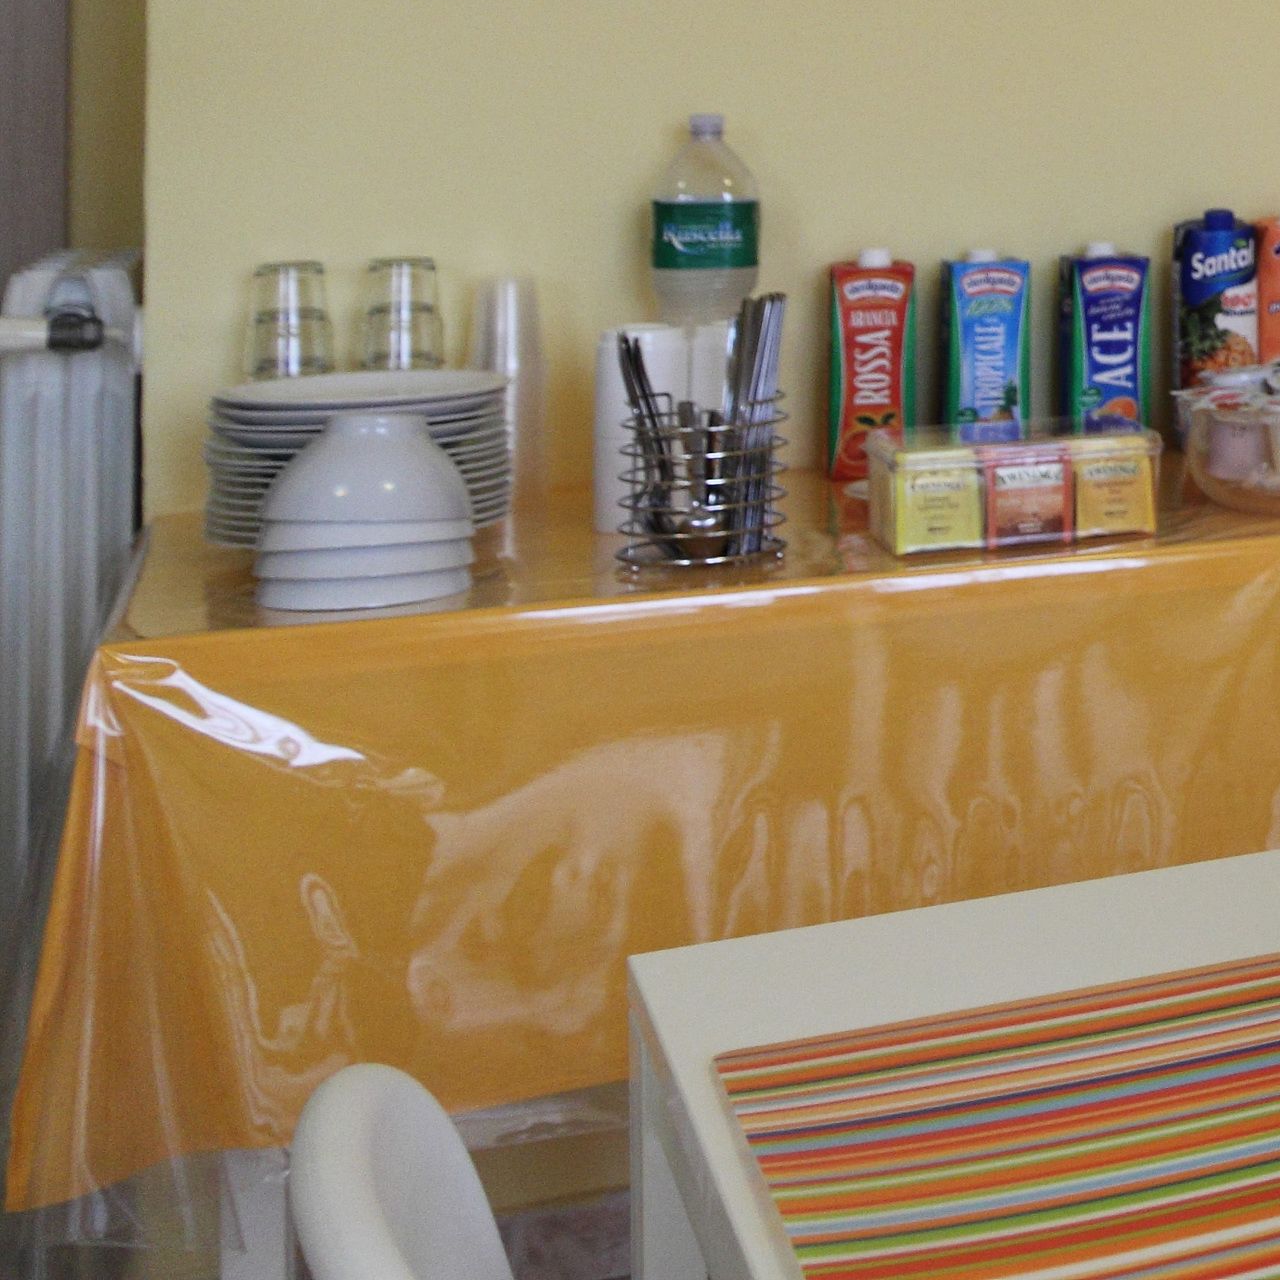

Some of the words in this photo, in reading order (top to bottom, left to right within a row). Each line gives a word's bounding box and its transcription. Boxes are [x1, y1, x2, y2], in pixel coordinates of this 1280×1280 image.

[853, 328, 893, 406] ROSSA
[974, 322, 1005, 408] TROPICALE
[1091, 321, 1135, 389] ACE
